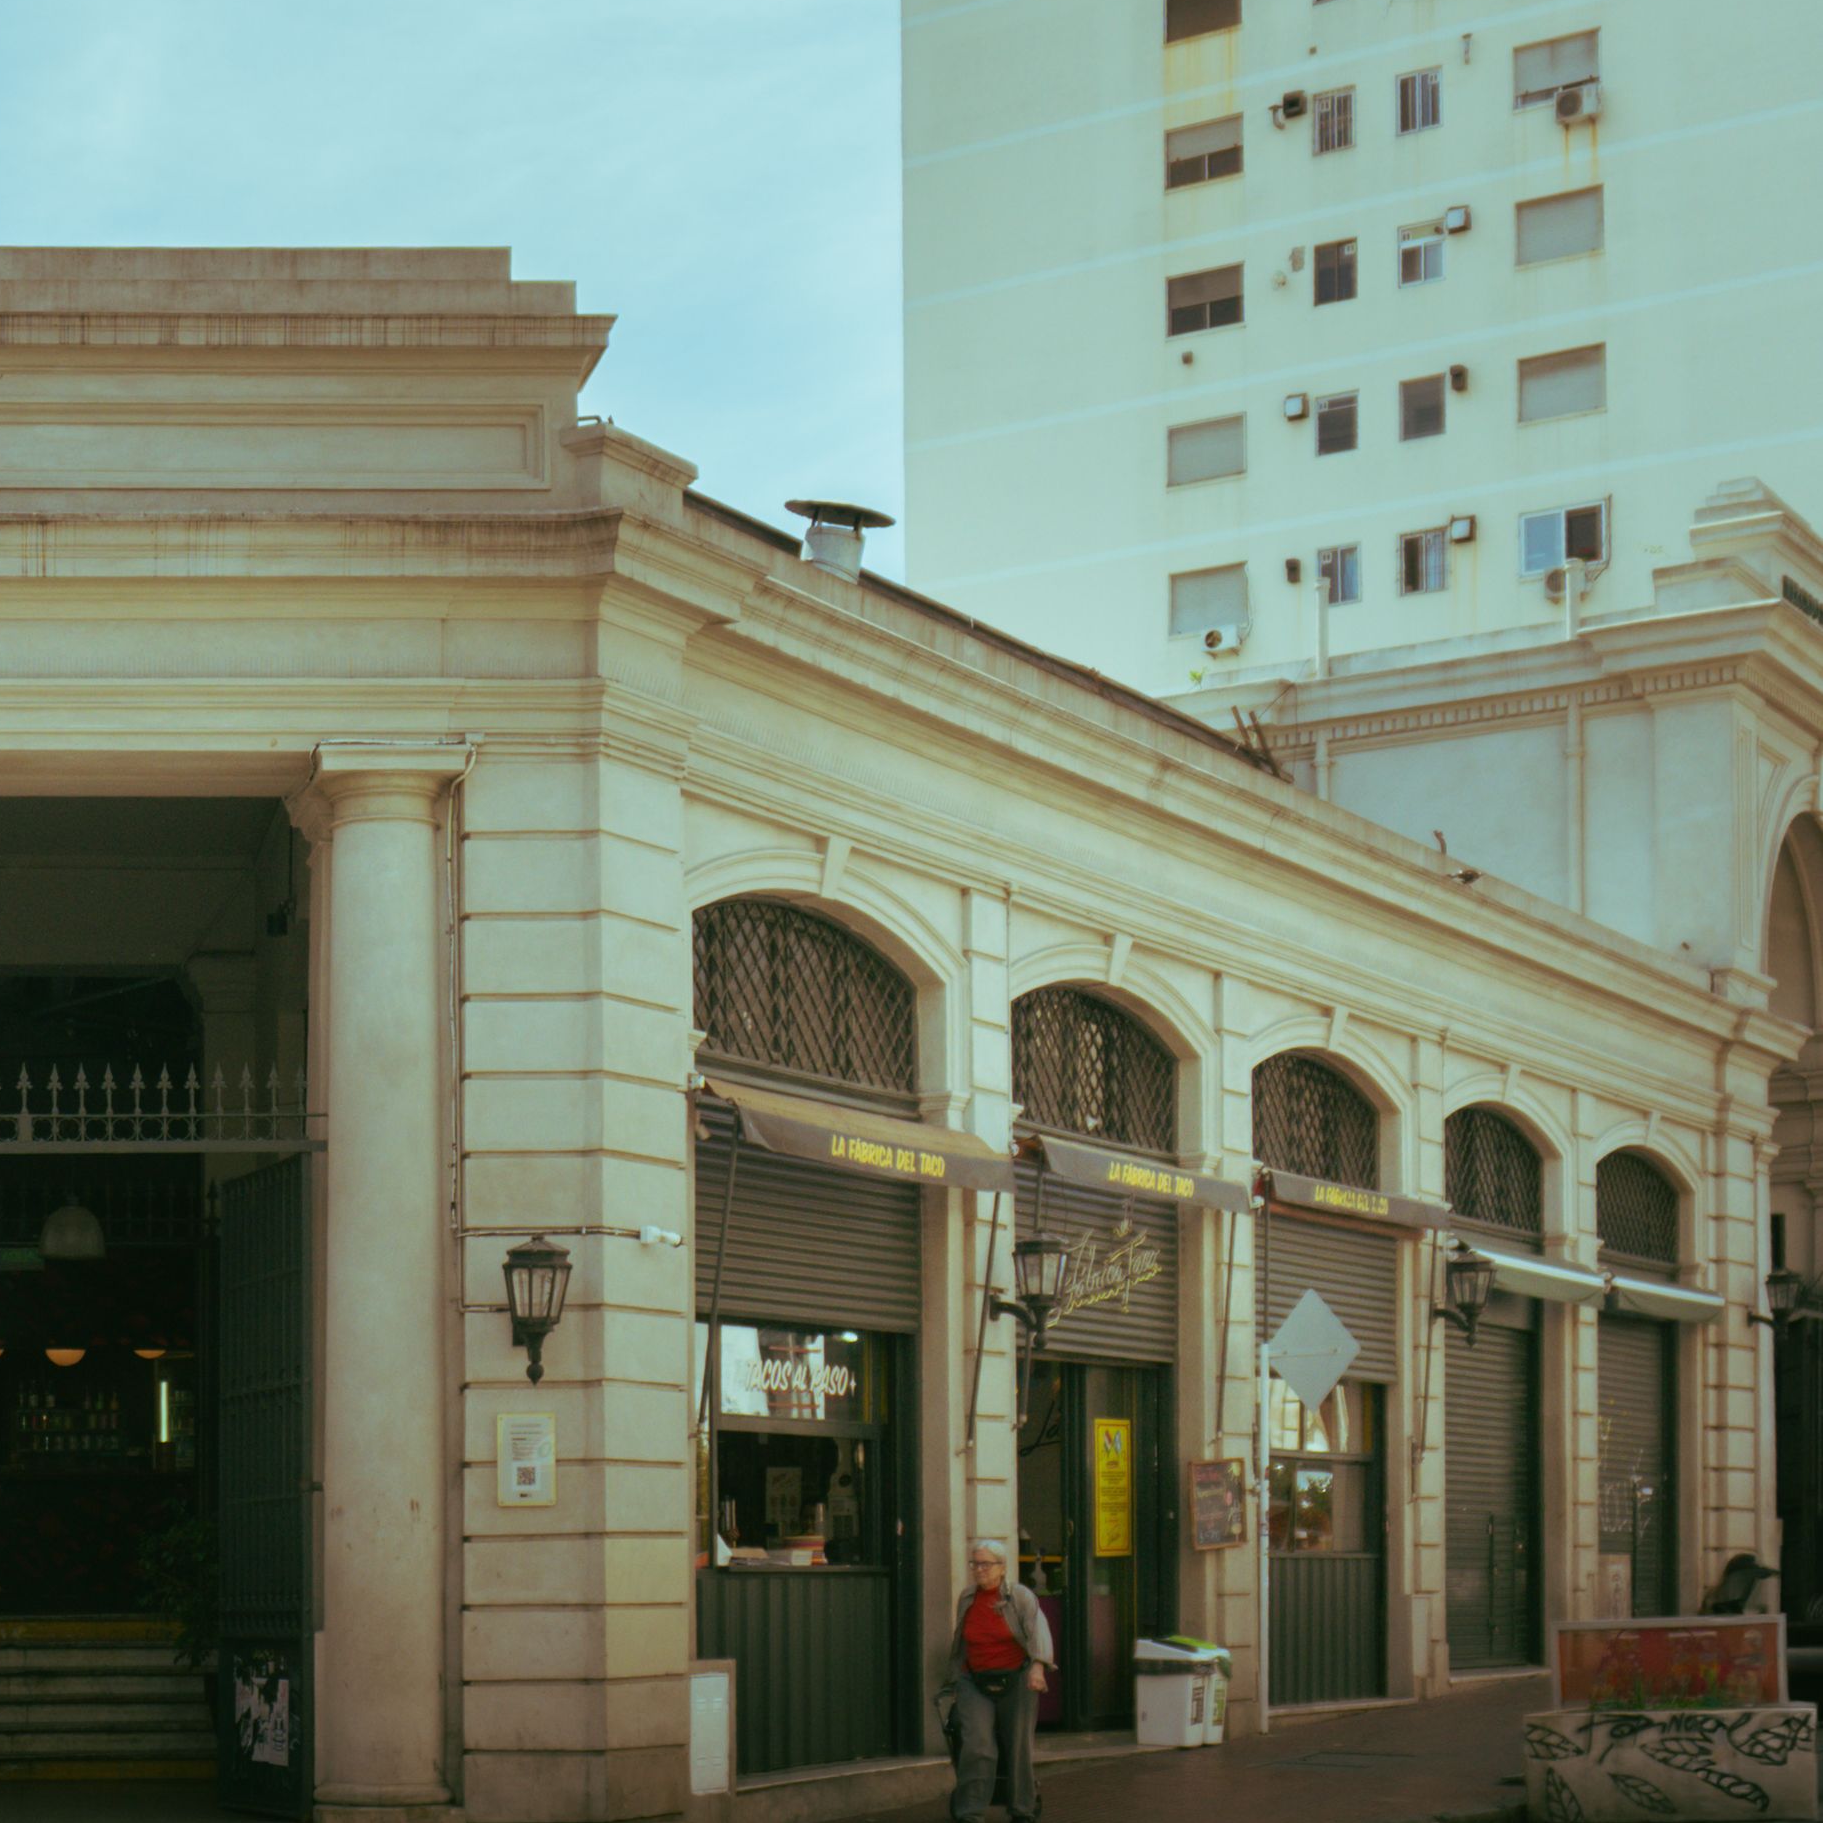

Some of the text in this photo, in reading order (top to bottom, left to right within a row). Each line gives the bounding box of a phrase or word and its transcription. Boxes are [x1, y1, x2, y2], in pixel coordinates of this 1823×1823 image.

[831, 1134, 945, 1178] LA FÁBRICA DEL TACO
[1109, 1161, 1121, 1182] LA
[744, 1358, 849, 1397] TACOS AL PASO
